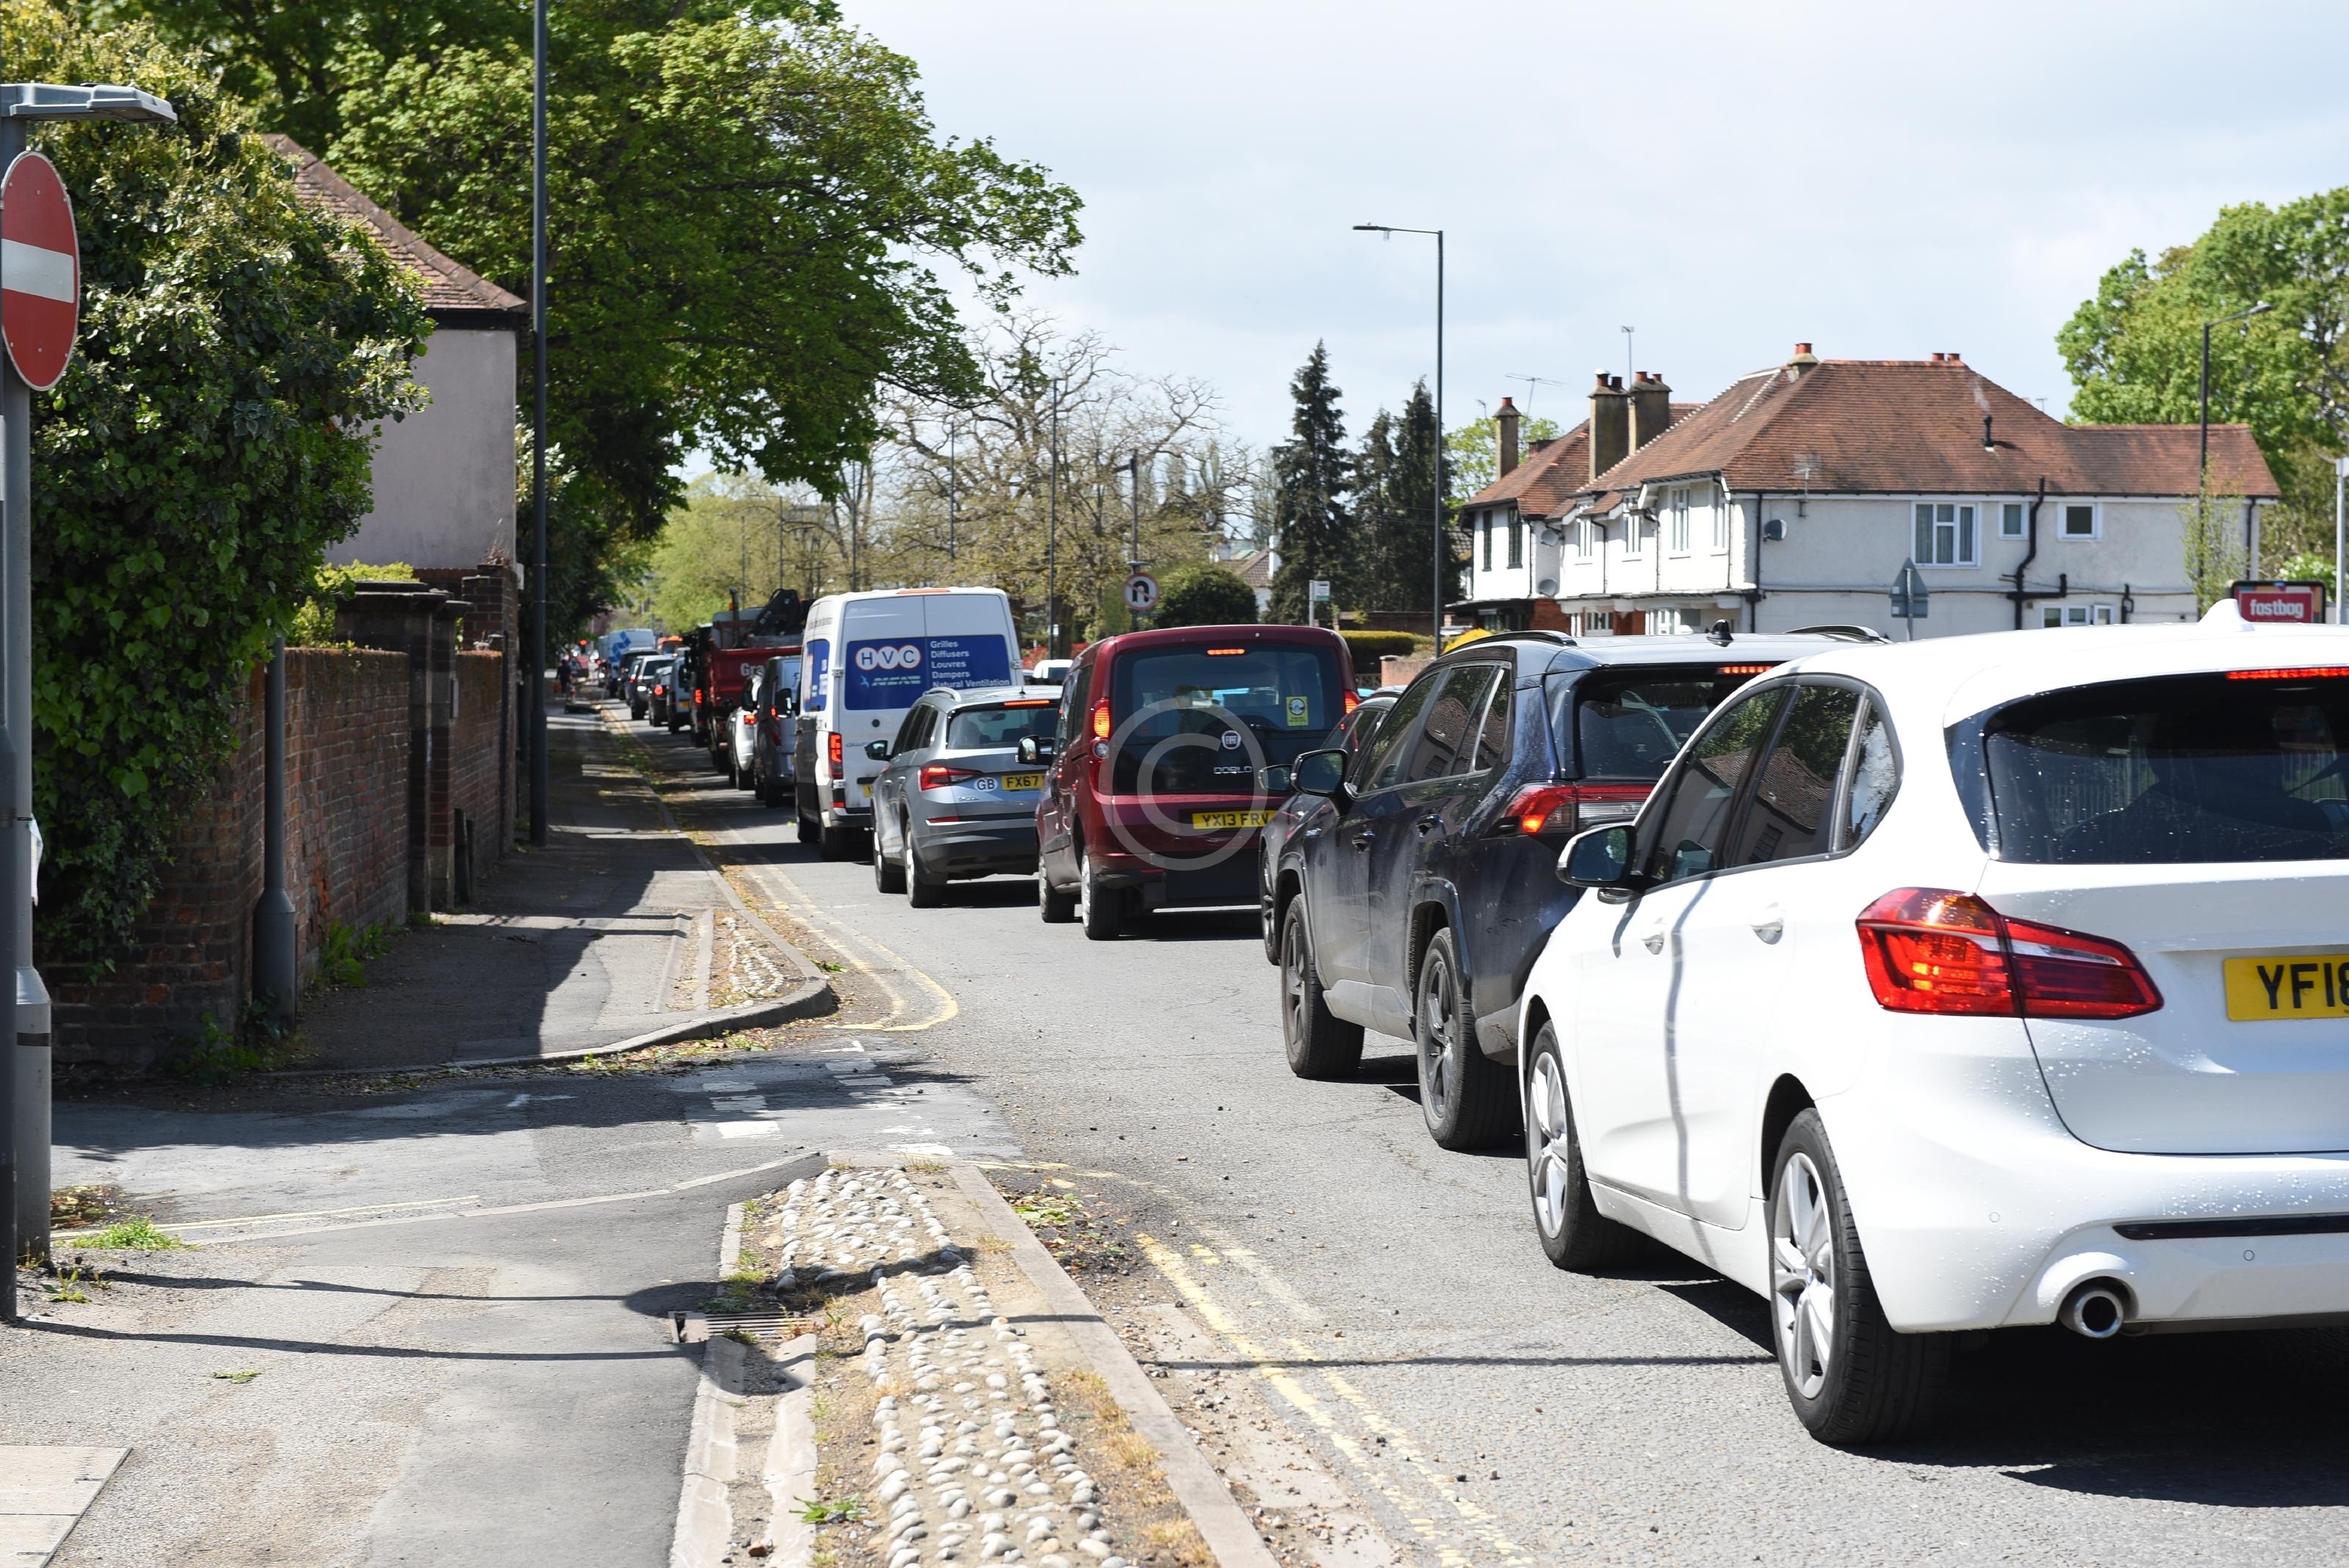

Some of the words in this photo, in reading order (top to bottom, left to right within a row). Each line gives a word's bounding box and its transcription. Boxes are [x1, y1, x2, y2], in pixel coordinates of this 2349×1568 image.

[930, 640, 959, 648] Grilles
[860, 649, 916, 666] HVC
[930, 650, 970, 658] Diffusers
[932, 671, 970, 679] Dampers
[932, 680, 963, 688] Natural
[965, 678, 1009, 687] Ventilation
[976, 779, 995, 791] GB
[1007, 775, 1039, 788] FX67
[1202, 813, 1236, 827] YX13
[1240, 813, 1268, 826] FRV
